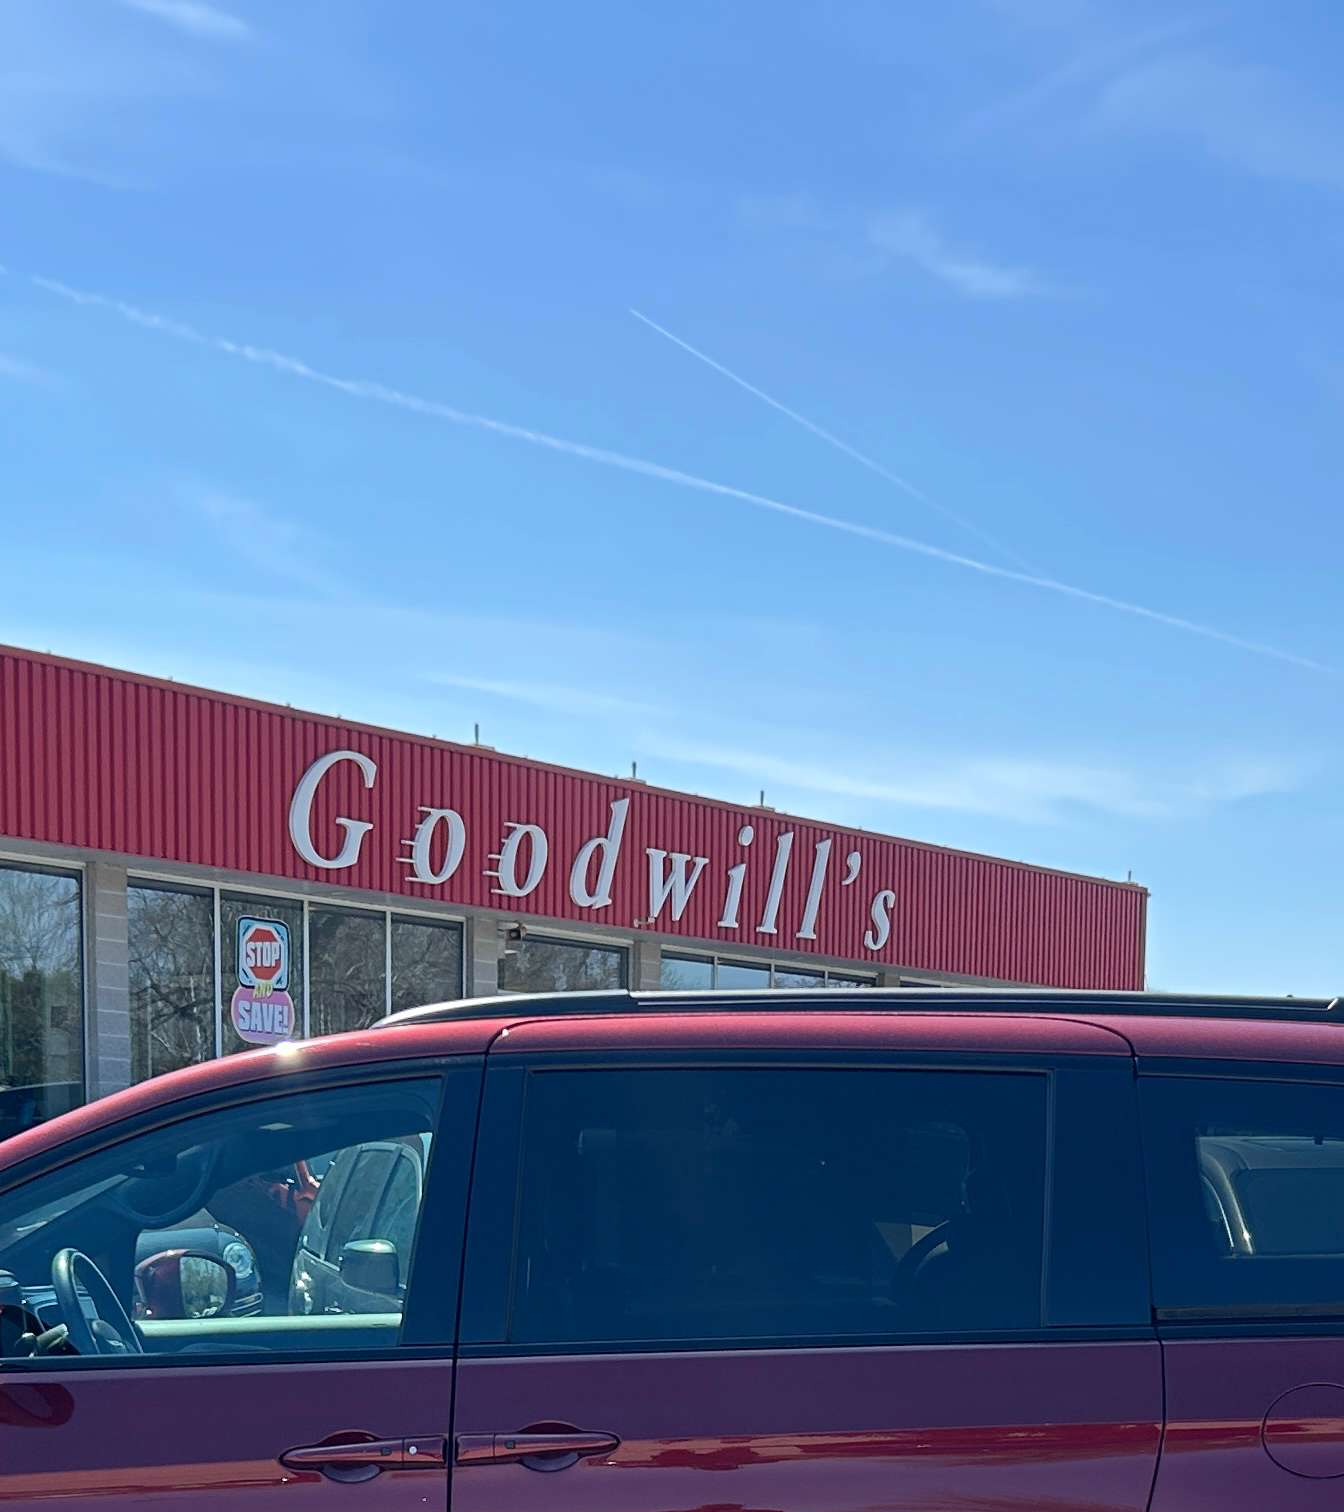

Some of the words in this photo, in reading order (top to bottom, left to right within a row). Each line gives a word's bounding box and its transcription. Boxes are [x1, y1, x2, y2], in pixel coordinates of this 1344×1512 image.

[289, 750, 896, 951] Goodwill's
[246, 941, 280, 968] STOP
[253, 984, 274, 999] AND
[238, 1000, 289, 1034] SAVE!
